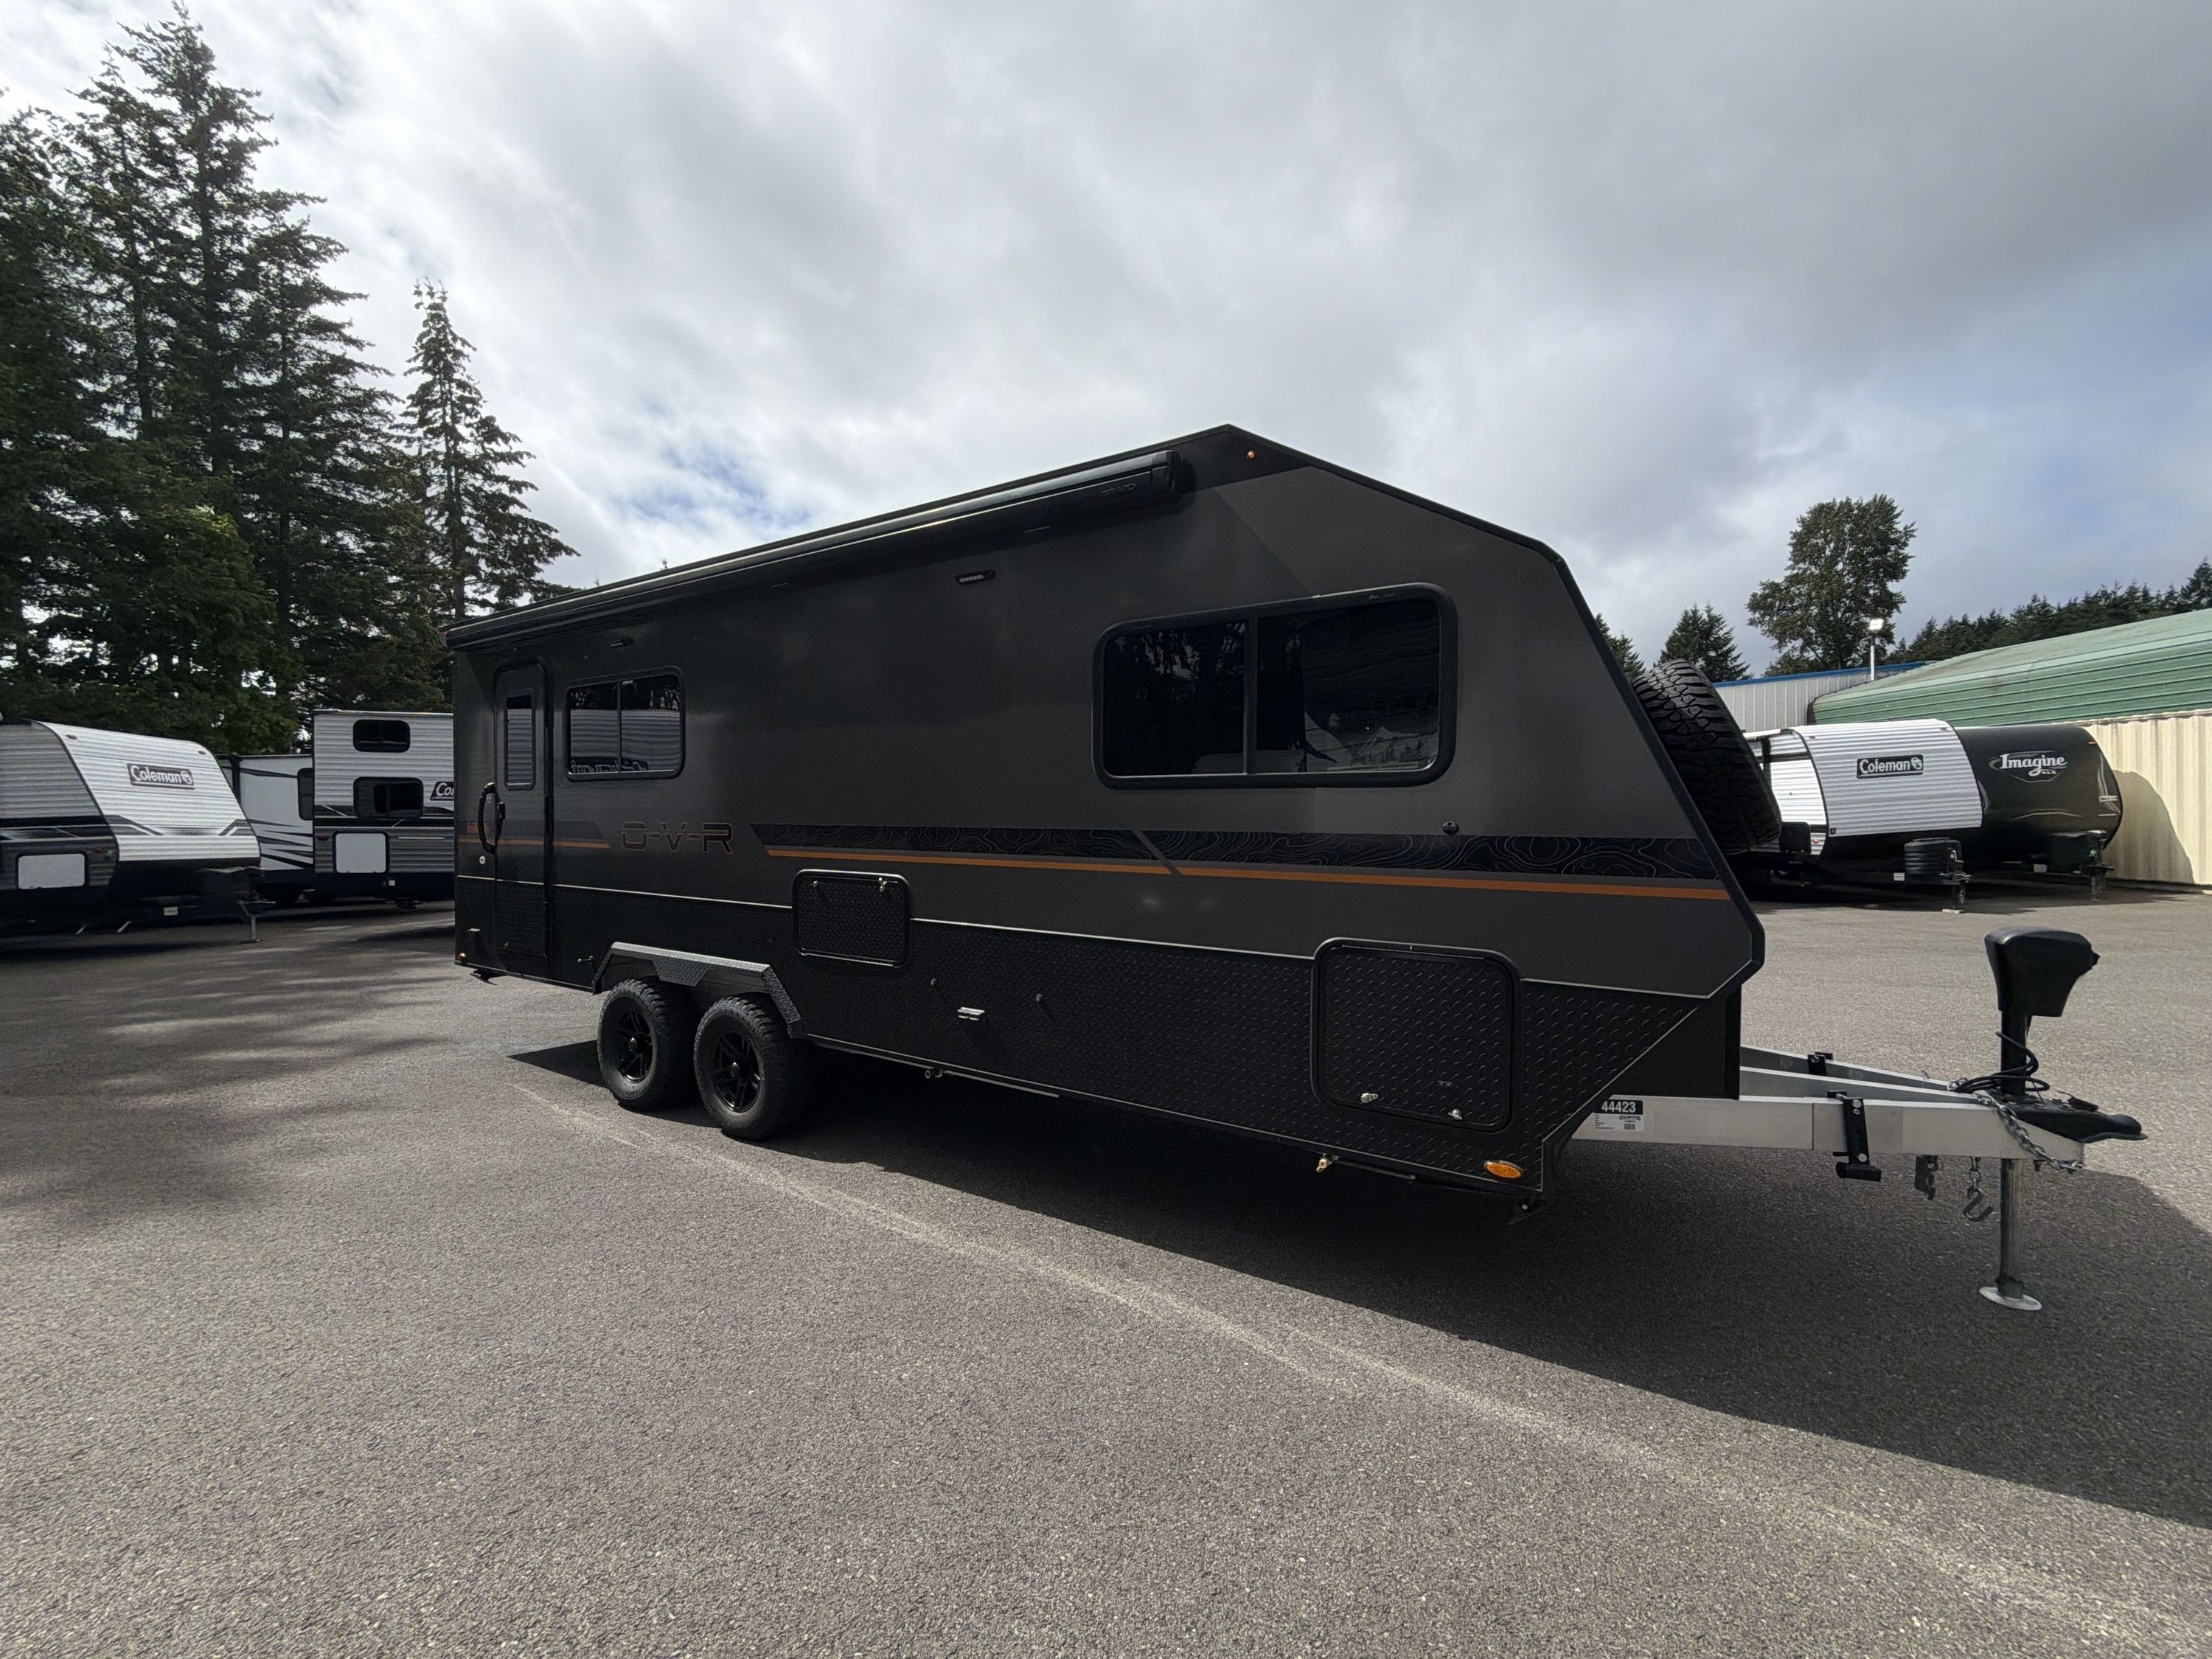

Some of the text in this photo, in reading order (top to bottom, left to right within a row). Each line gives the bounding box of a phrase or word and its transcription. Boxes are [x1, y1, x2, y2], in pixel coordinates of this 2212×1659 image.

[1860, 759, 1910, 774] Coleman
[2000, 754, 2067, 776] Imagine
[131, 765, 182, 783] Coleman
[1601, 1101, 1636, 1113] 44423
